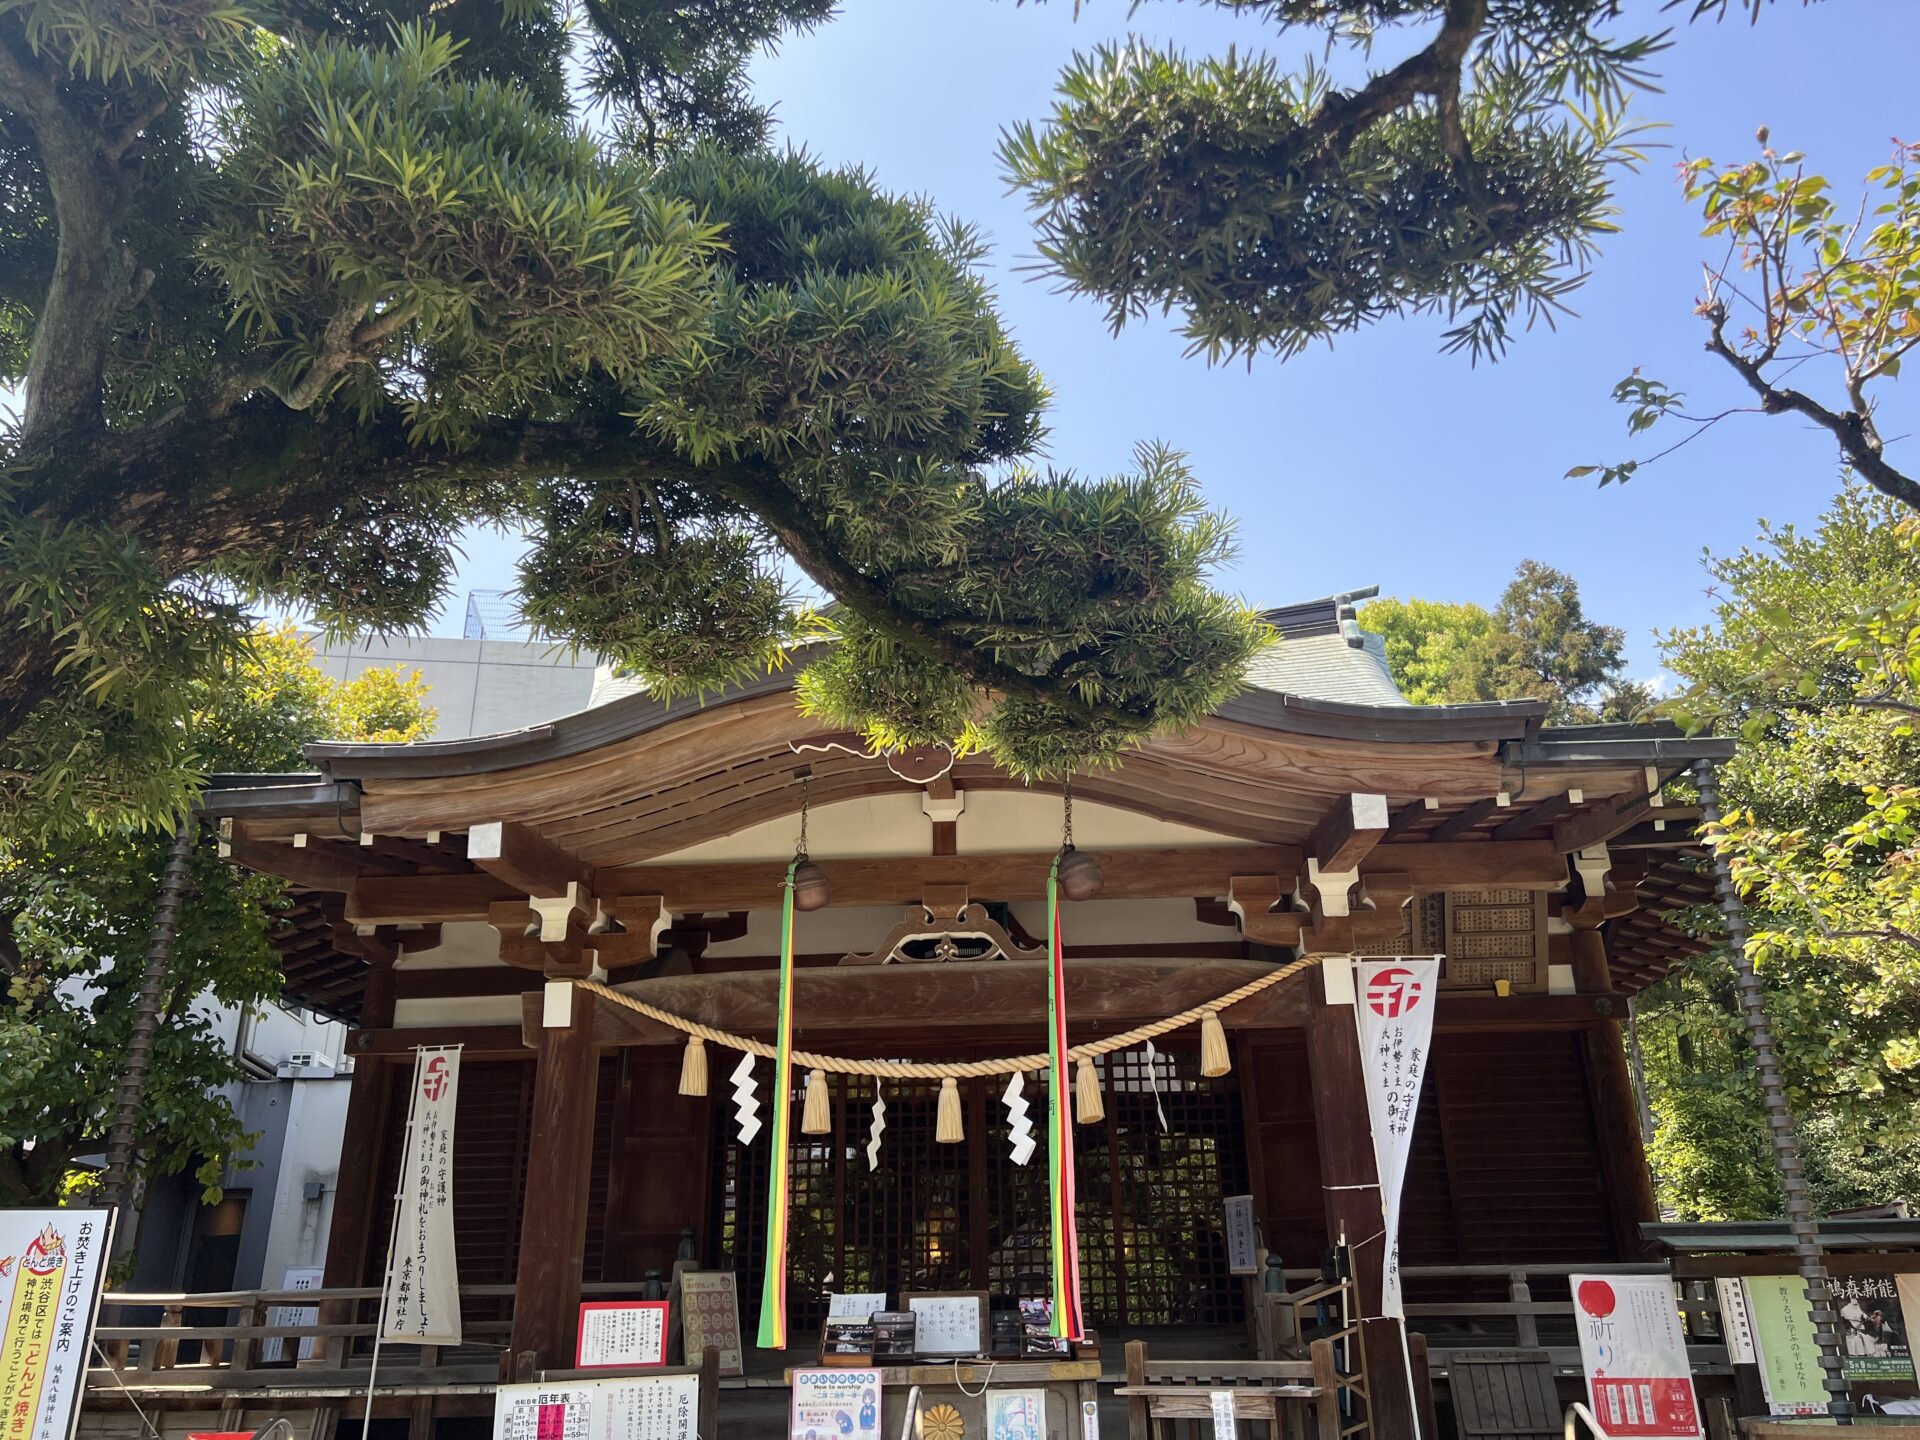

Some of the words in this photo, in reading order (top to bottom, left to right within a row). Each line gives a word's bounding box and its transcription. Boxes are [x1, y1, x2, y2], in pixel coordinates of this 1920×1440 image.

[1380, 1027, 1390, 1088] 氏神さま
[1393, 1026, 1403, 1087] お伊勢さま
[1397, 1047, 1421, 1137] 家庭の守護神
[437, 1129, 448, 1206] 家庭の守護神
[22, 1256, 64, 1268] どんど焼き
[55, 1221, 94, 1353] お焚き上げのご案内
[417, 1164, 430, 1337] の御神札をおまつりしましょう
[1826, 1275, 1898, 1299] 鳩森薪能
[394, 1256, 413, 1331] 東京都神社庁
[1778, 1287, 1807, 1390] 教うるは学ぶの半ばなり
